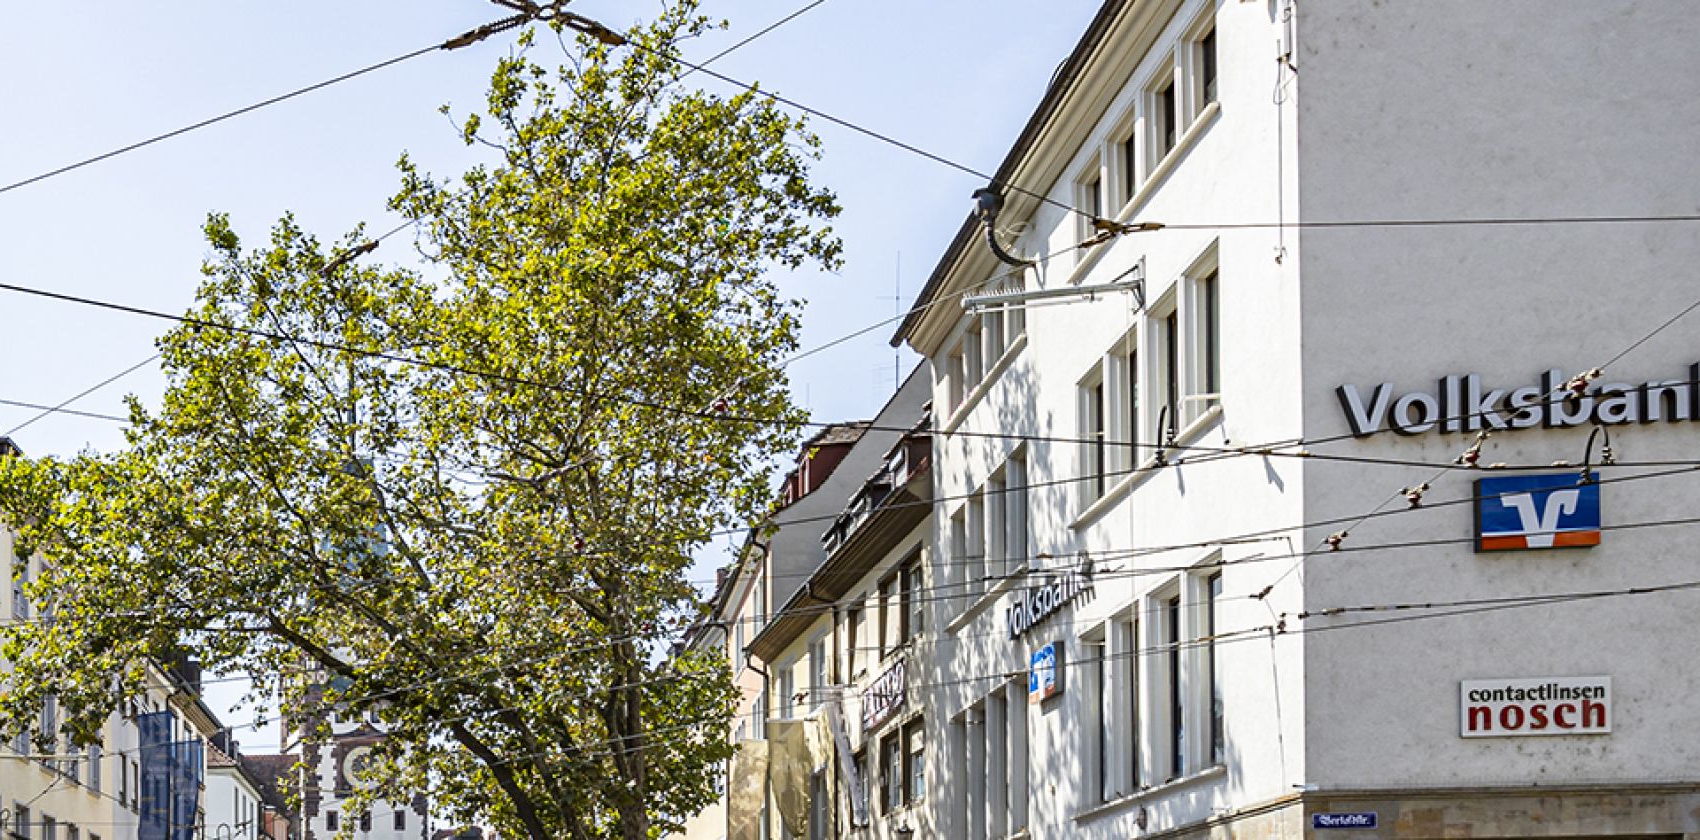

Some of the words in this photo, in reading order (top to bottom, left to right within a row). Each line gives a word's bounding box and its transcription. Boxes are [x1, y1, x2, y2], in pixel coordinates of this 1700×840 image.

[1335, 361, 1700, 437] Volksban
[1468, 683, 1605, 702] contactlinsen
[1468, 698, 1606, 731] nosch
